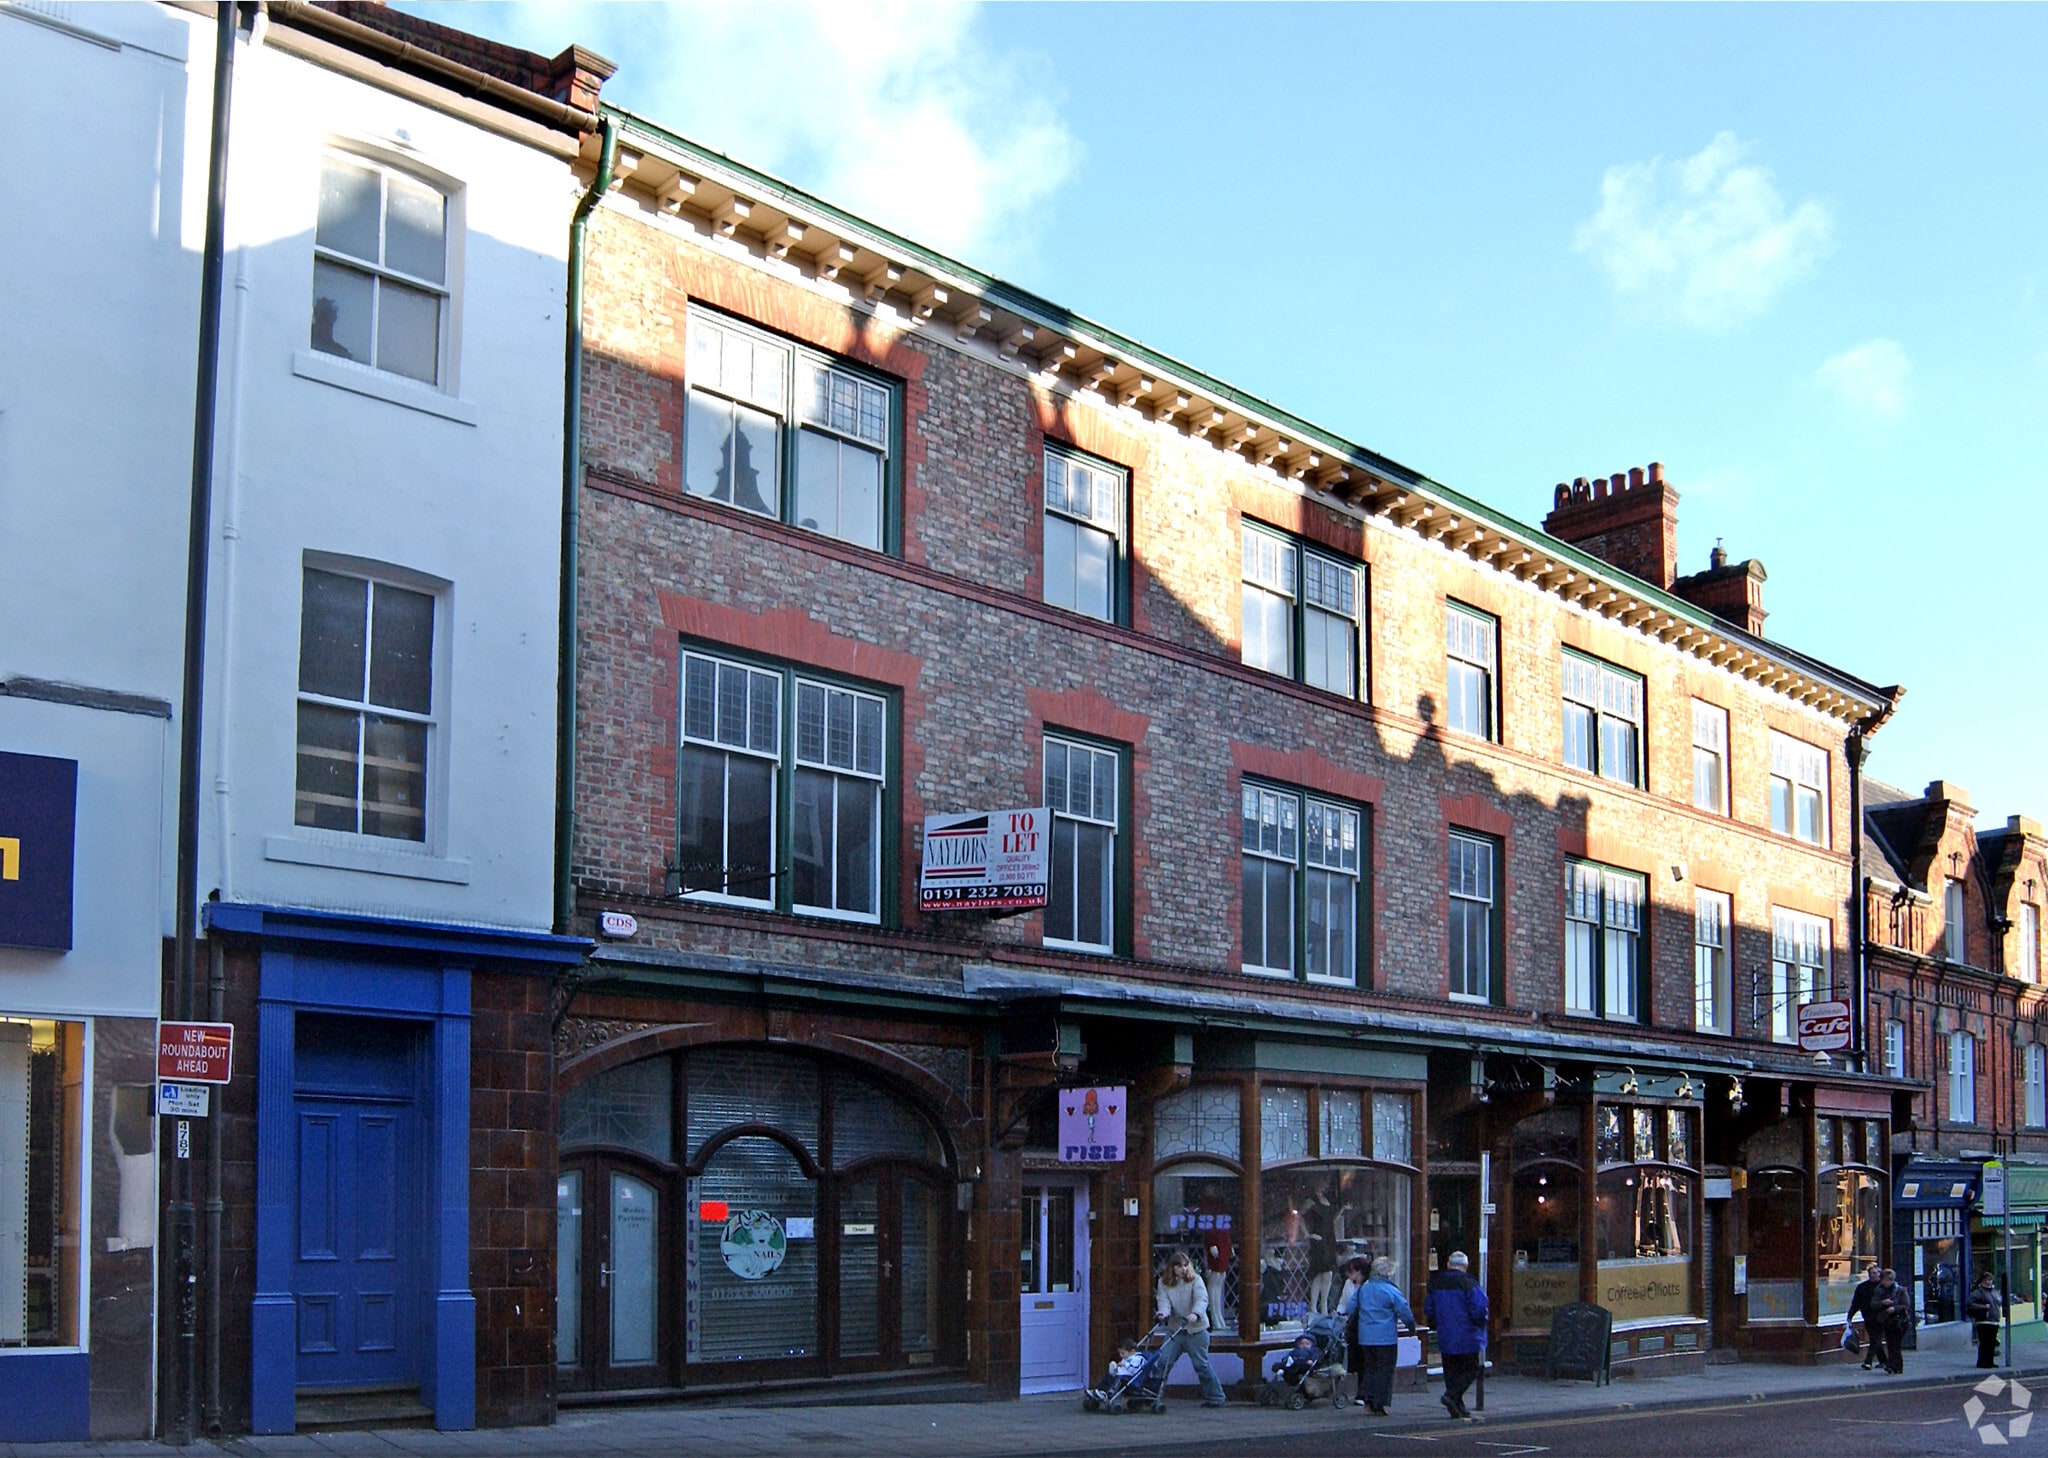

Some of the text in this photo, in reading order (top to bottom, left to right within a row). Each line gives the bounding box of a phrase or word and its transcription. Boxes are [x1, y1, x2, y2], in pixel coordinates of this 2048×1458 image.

[1009, 812, 1034, 832] TO
[1003, 832, 1039, 853] LET
[926, 837, 987, 866] NAYLORS
[1006, 854, 1030, 863] QUALITY
[996, 864, 1020, 872] OFFICES
[923, 884, 1044, 901] 0191 232 7030
[923, 898, 1044, 908] www.naylors.co.uk
[607, 916, 633, 928] CDS
[1799, 1018, 1850, 1034] Cafe
[183, 1029, 206, 1042] NEW
[161, 1043, 227, 1060] ROUNDABOUT
[176, 1060, 208, 1074] AHEAD
[179, 1122, 188, 1157] 4787
[753, 1250, 782, 1259] NAILS
[1524, 1277, 1567, 1289] Coffee
